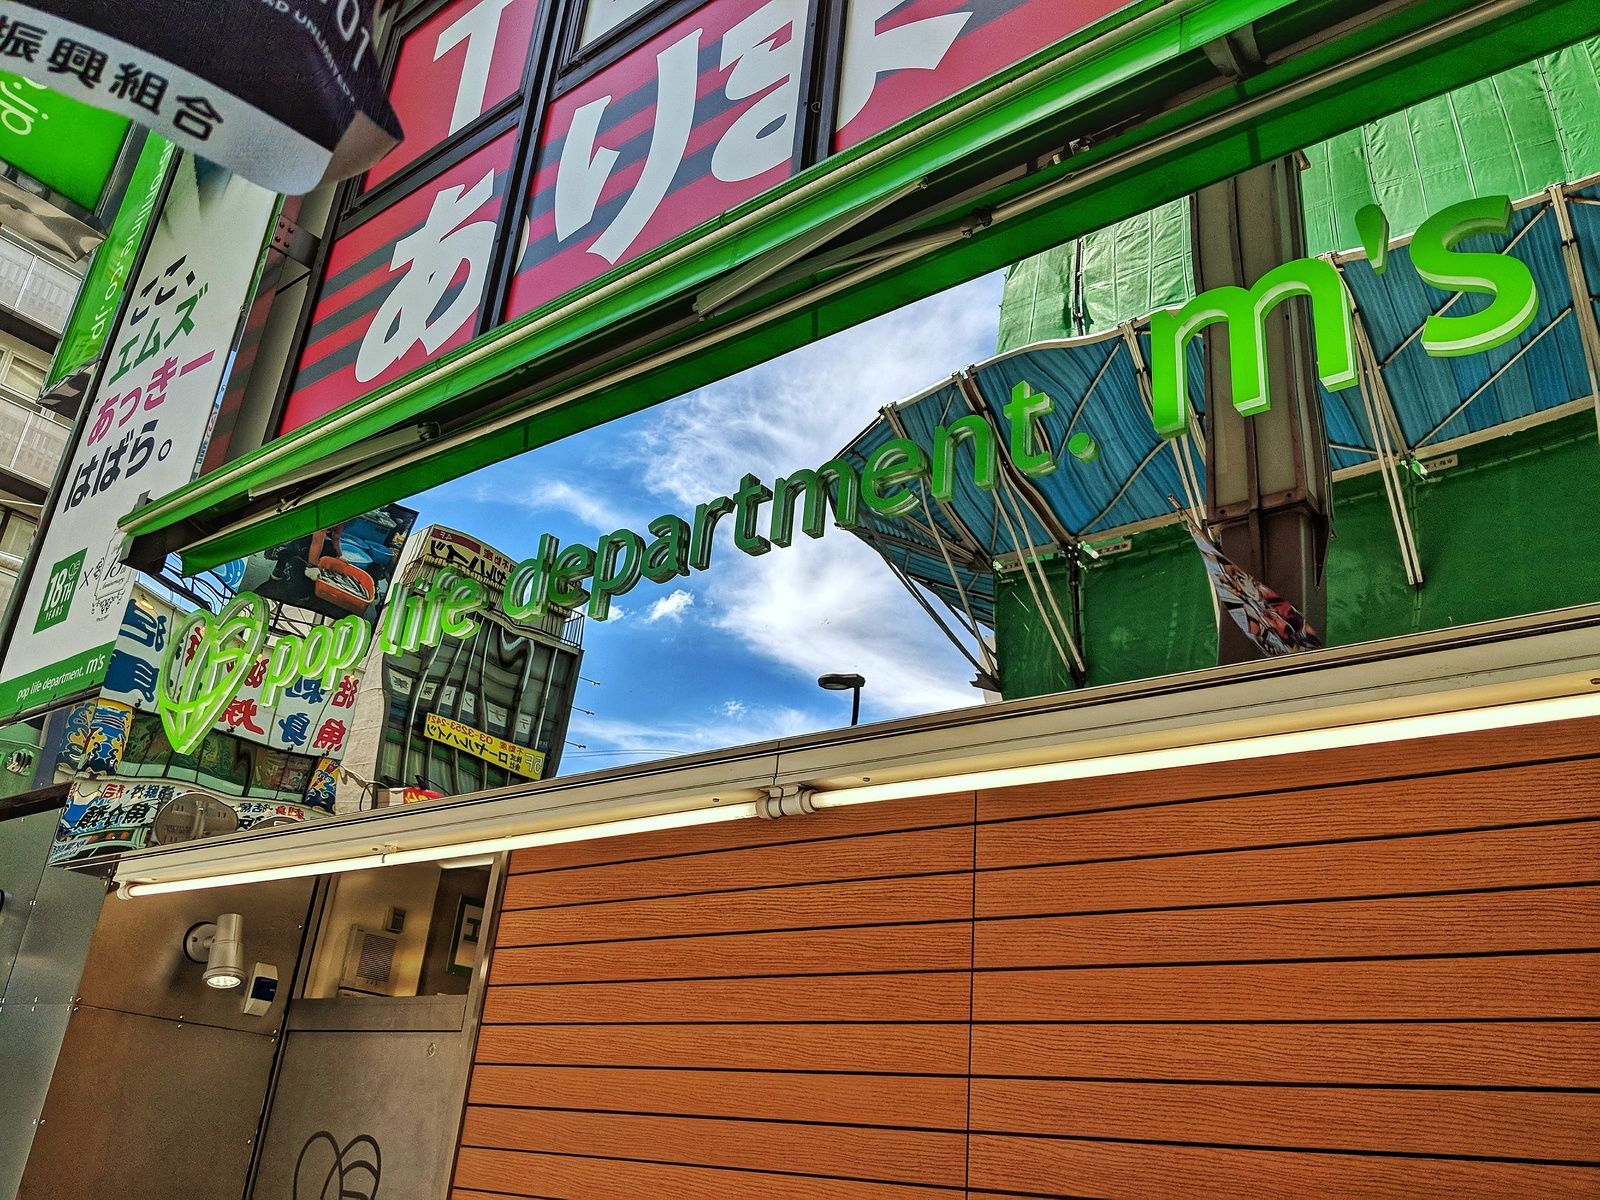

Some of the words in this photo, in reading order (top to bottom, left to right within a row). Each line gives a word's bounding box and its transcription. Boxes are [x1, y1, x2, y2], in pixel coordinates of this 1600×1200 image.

[107, 282, 209, 387] エムズ
[1151, 194, 1539, 440] m's
[63, 418, 173, 514] はばら。
[260, 614, 371, 707] pop
[380, 565, 488, 656] life
[502, 380, 1100, 622] department.
[16, 684, 30, 702] pop
[30, 681, 43, 694] life
[42, 667, 84, 692] department.
[85, 653, 106, 674] m's
